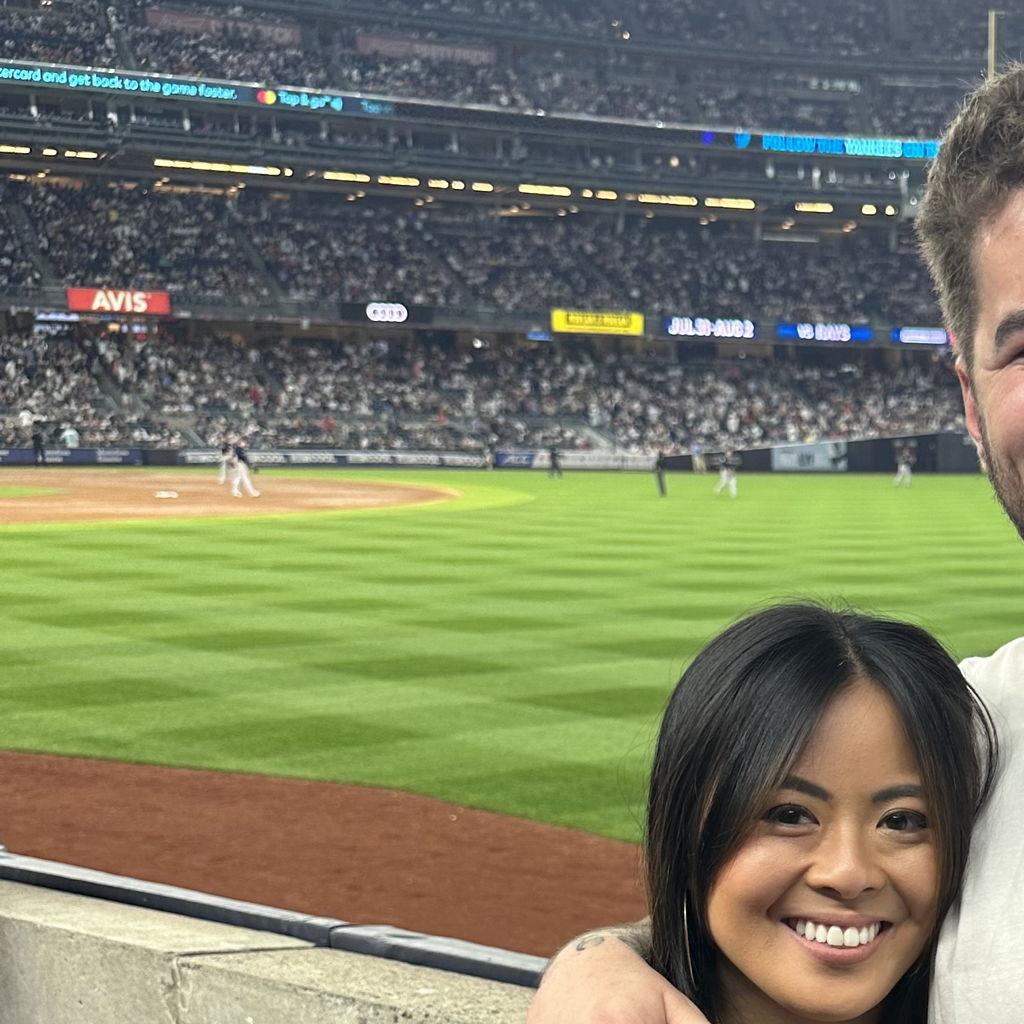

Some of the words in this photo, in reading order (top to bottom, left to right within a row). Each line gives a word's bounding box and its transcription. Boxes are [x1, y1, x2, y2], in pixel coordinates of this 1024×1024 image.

[42, 71, 67, 84] and
[68, 73, 91, 87] get
[92, 74, 123, 89] back
[123, 78, 138, 90] to
[139, 79, 161, 93] the
[162, 83, 197, 96] game
[278, 89, 300, 107] Tap
[91, 289, 148, 313] AVIS
[668, 317, 693, 336] JUL
